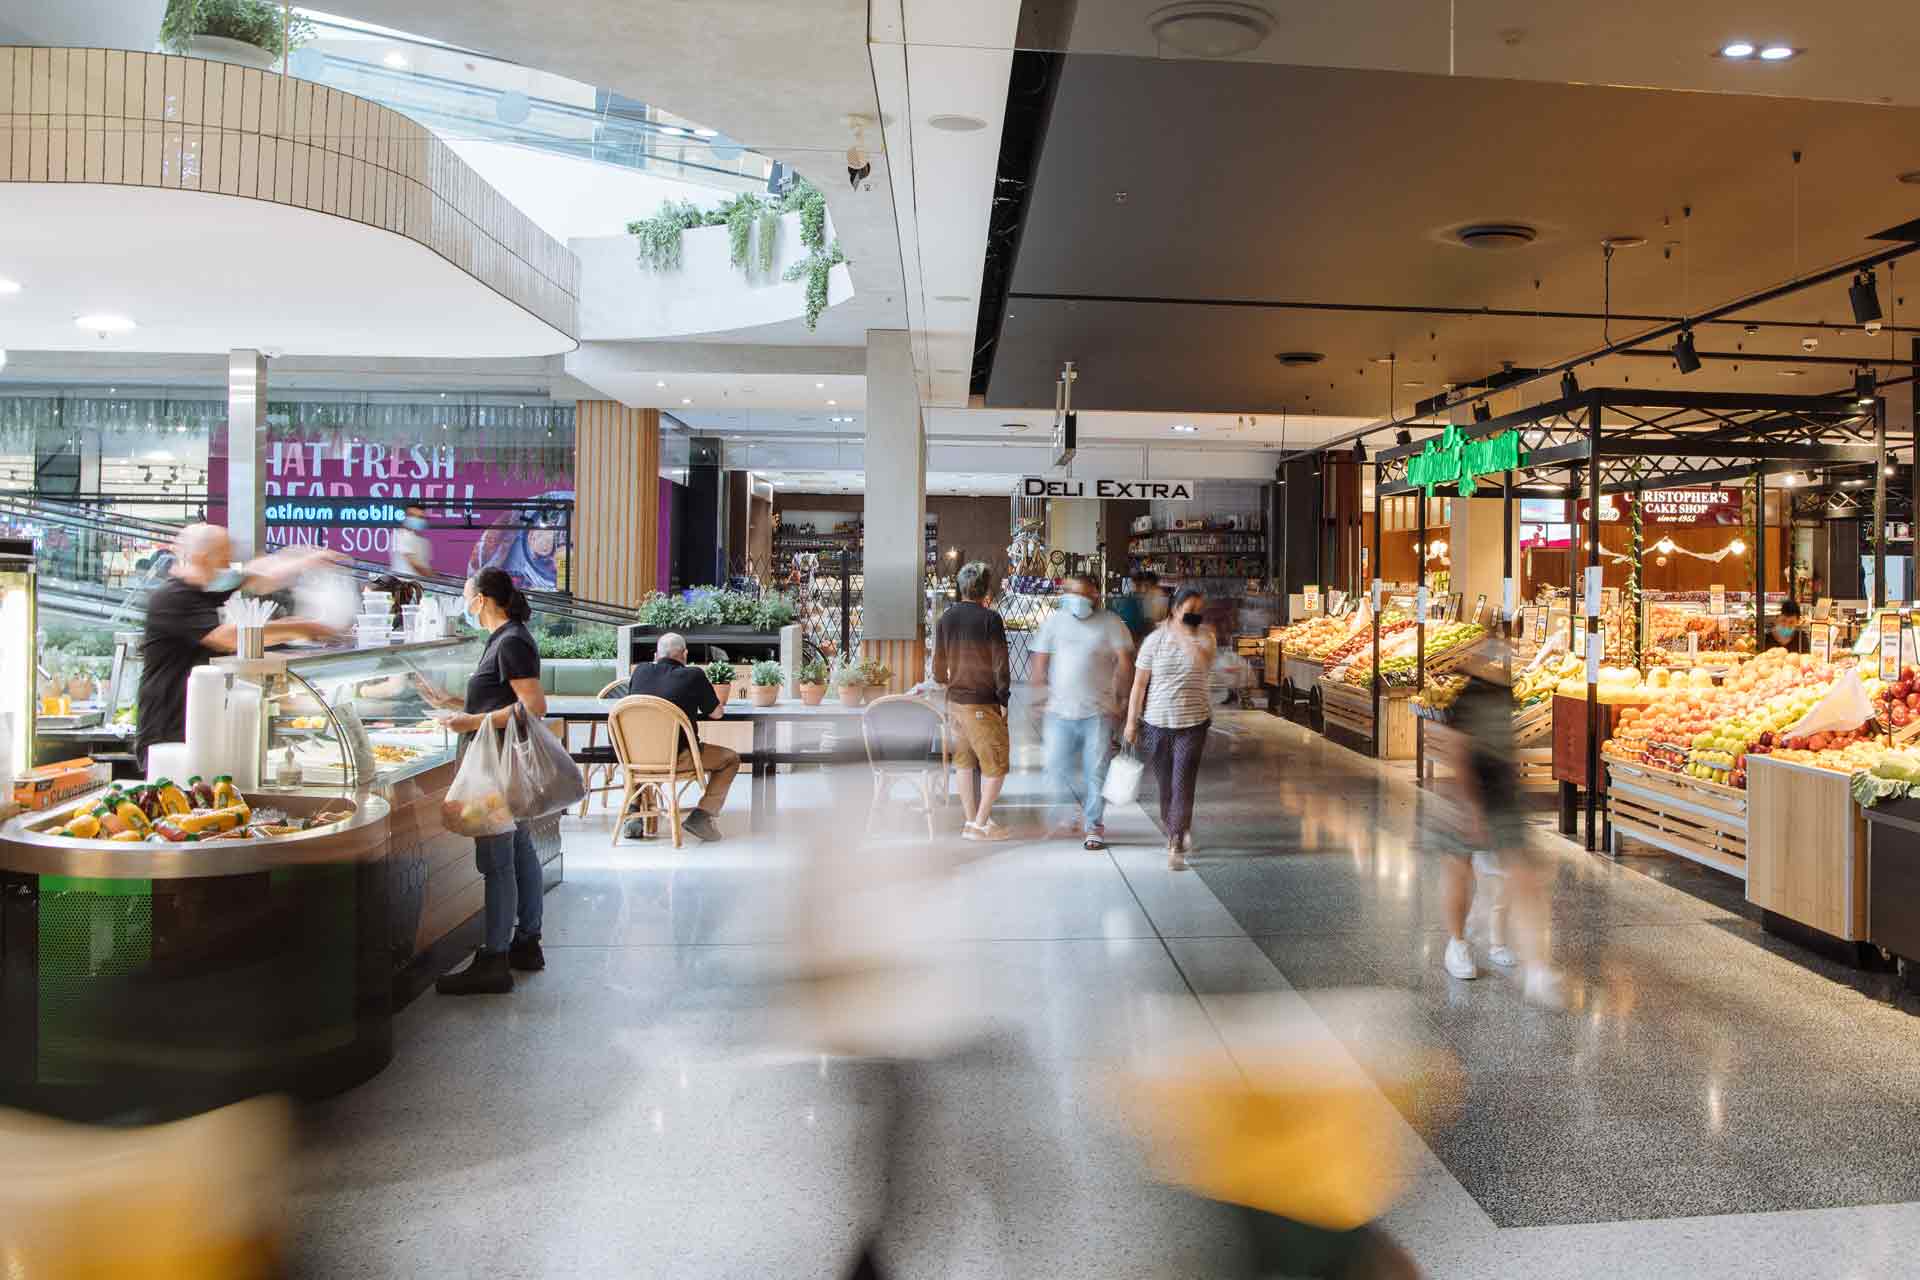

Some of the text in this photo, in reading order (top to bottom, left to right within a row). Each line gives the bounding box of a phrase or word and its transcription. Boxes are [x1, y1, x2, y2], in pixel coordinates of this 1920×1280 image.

[343, 443, 454, 479] FRESH
[265, 503, 406, 521] atinum mobile
[1645, 504, 1709, 514] CAKE SHOP
[266, 526, 329, 550] MING
